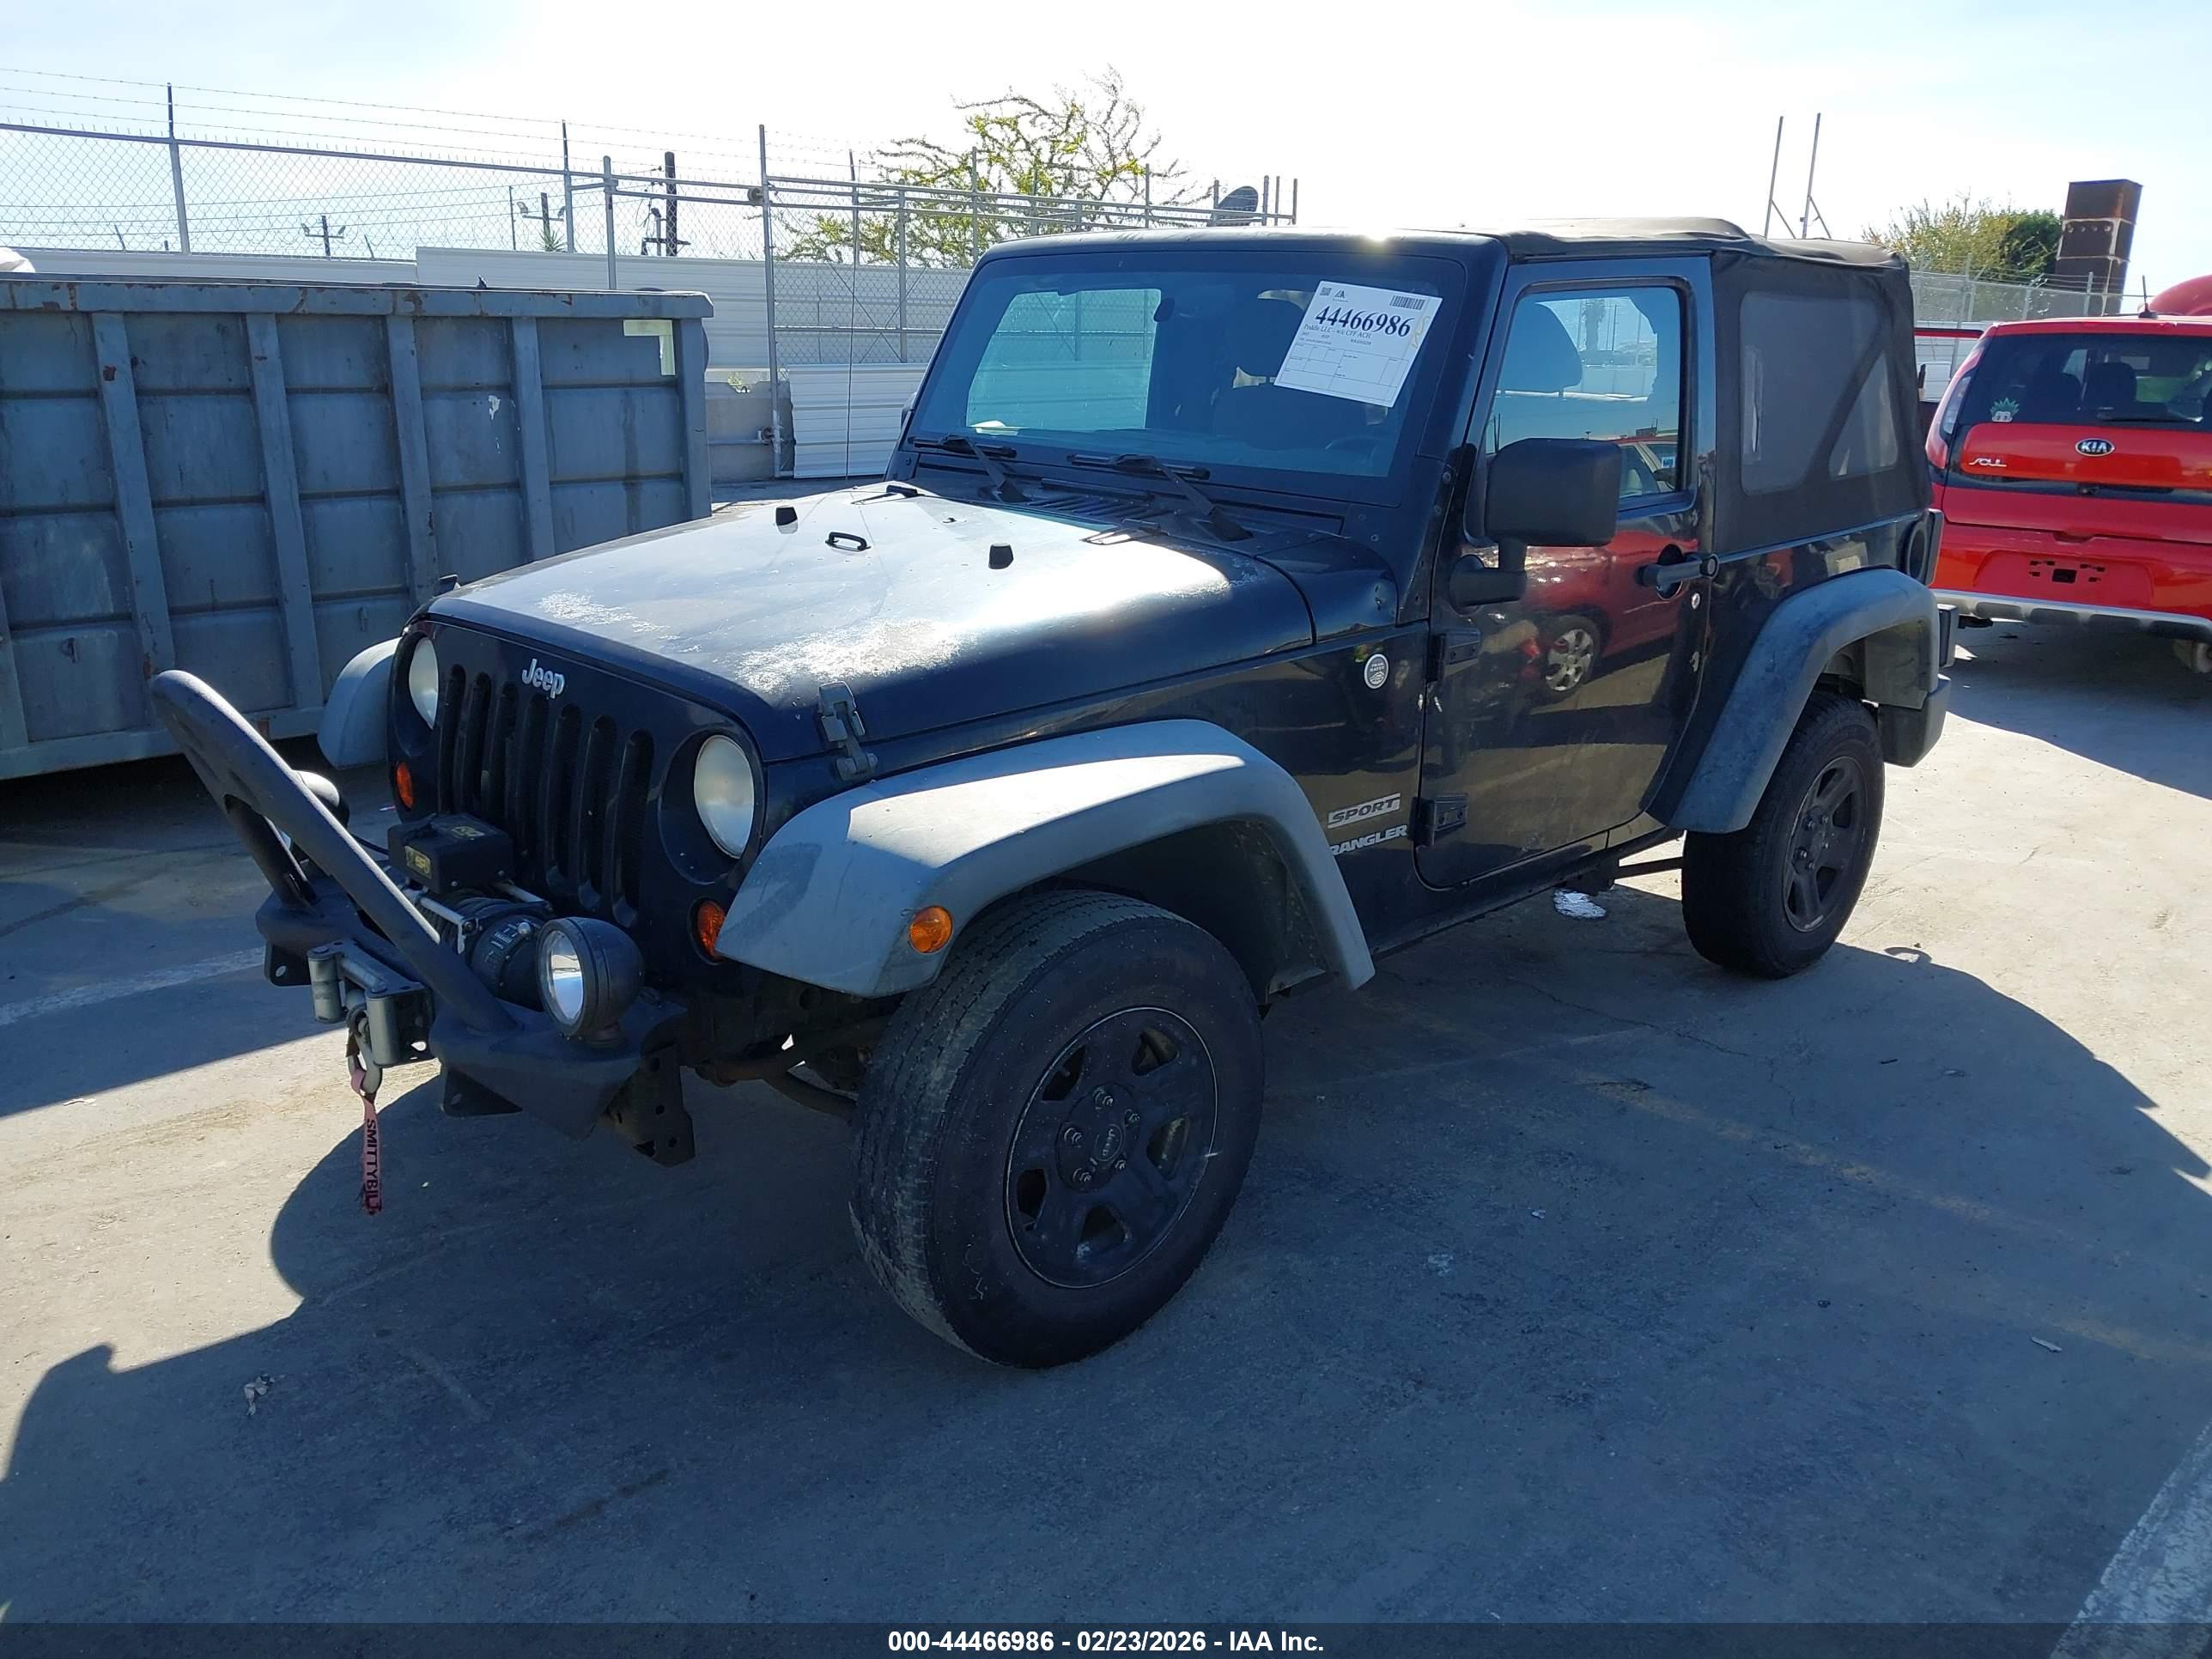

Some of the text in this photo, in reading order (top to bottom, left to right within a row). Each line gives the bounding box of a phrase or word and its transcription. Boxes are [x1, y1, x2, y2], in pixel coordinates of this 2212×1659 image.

[1315, 305, 1415, 337] 44466986
[2080, 441, 2108, 453] KIA
[1968, 457, 2008, 467] SOUL
[522, 658, 565, 699] Jeep
[1329, 797, 1401, 824] SPORT
[1329, 824, 1407, 856] RANGLER
